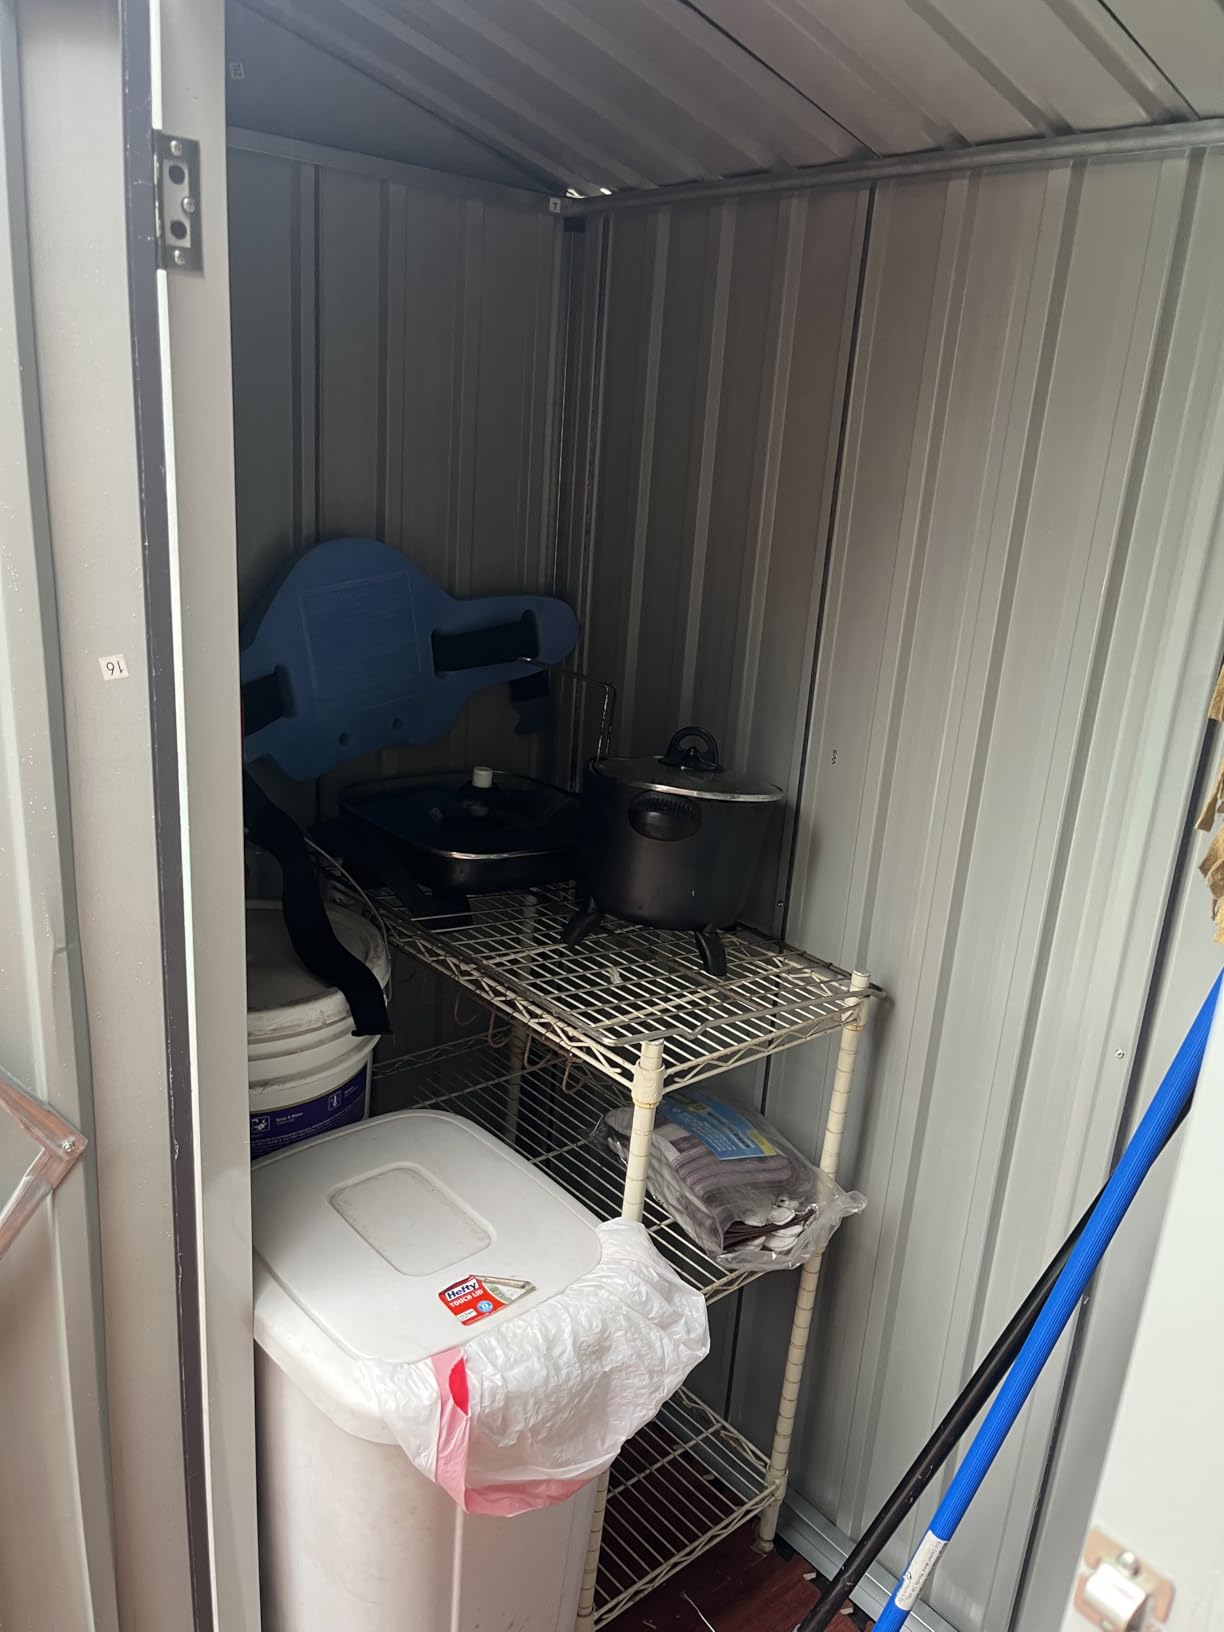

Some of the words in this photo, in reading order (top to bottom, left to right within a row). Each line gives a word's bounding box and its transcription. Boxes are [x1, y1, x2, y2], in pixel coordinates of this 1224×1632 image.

[447, 1282, 476, 1300] Hefty
[449, 1294, 472, 1307] TOUCH
[472, 1289, 484, 1298] LID
